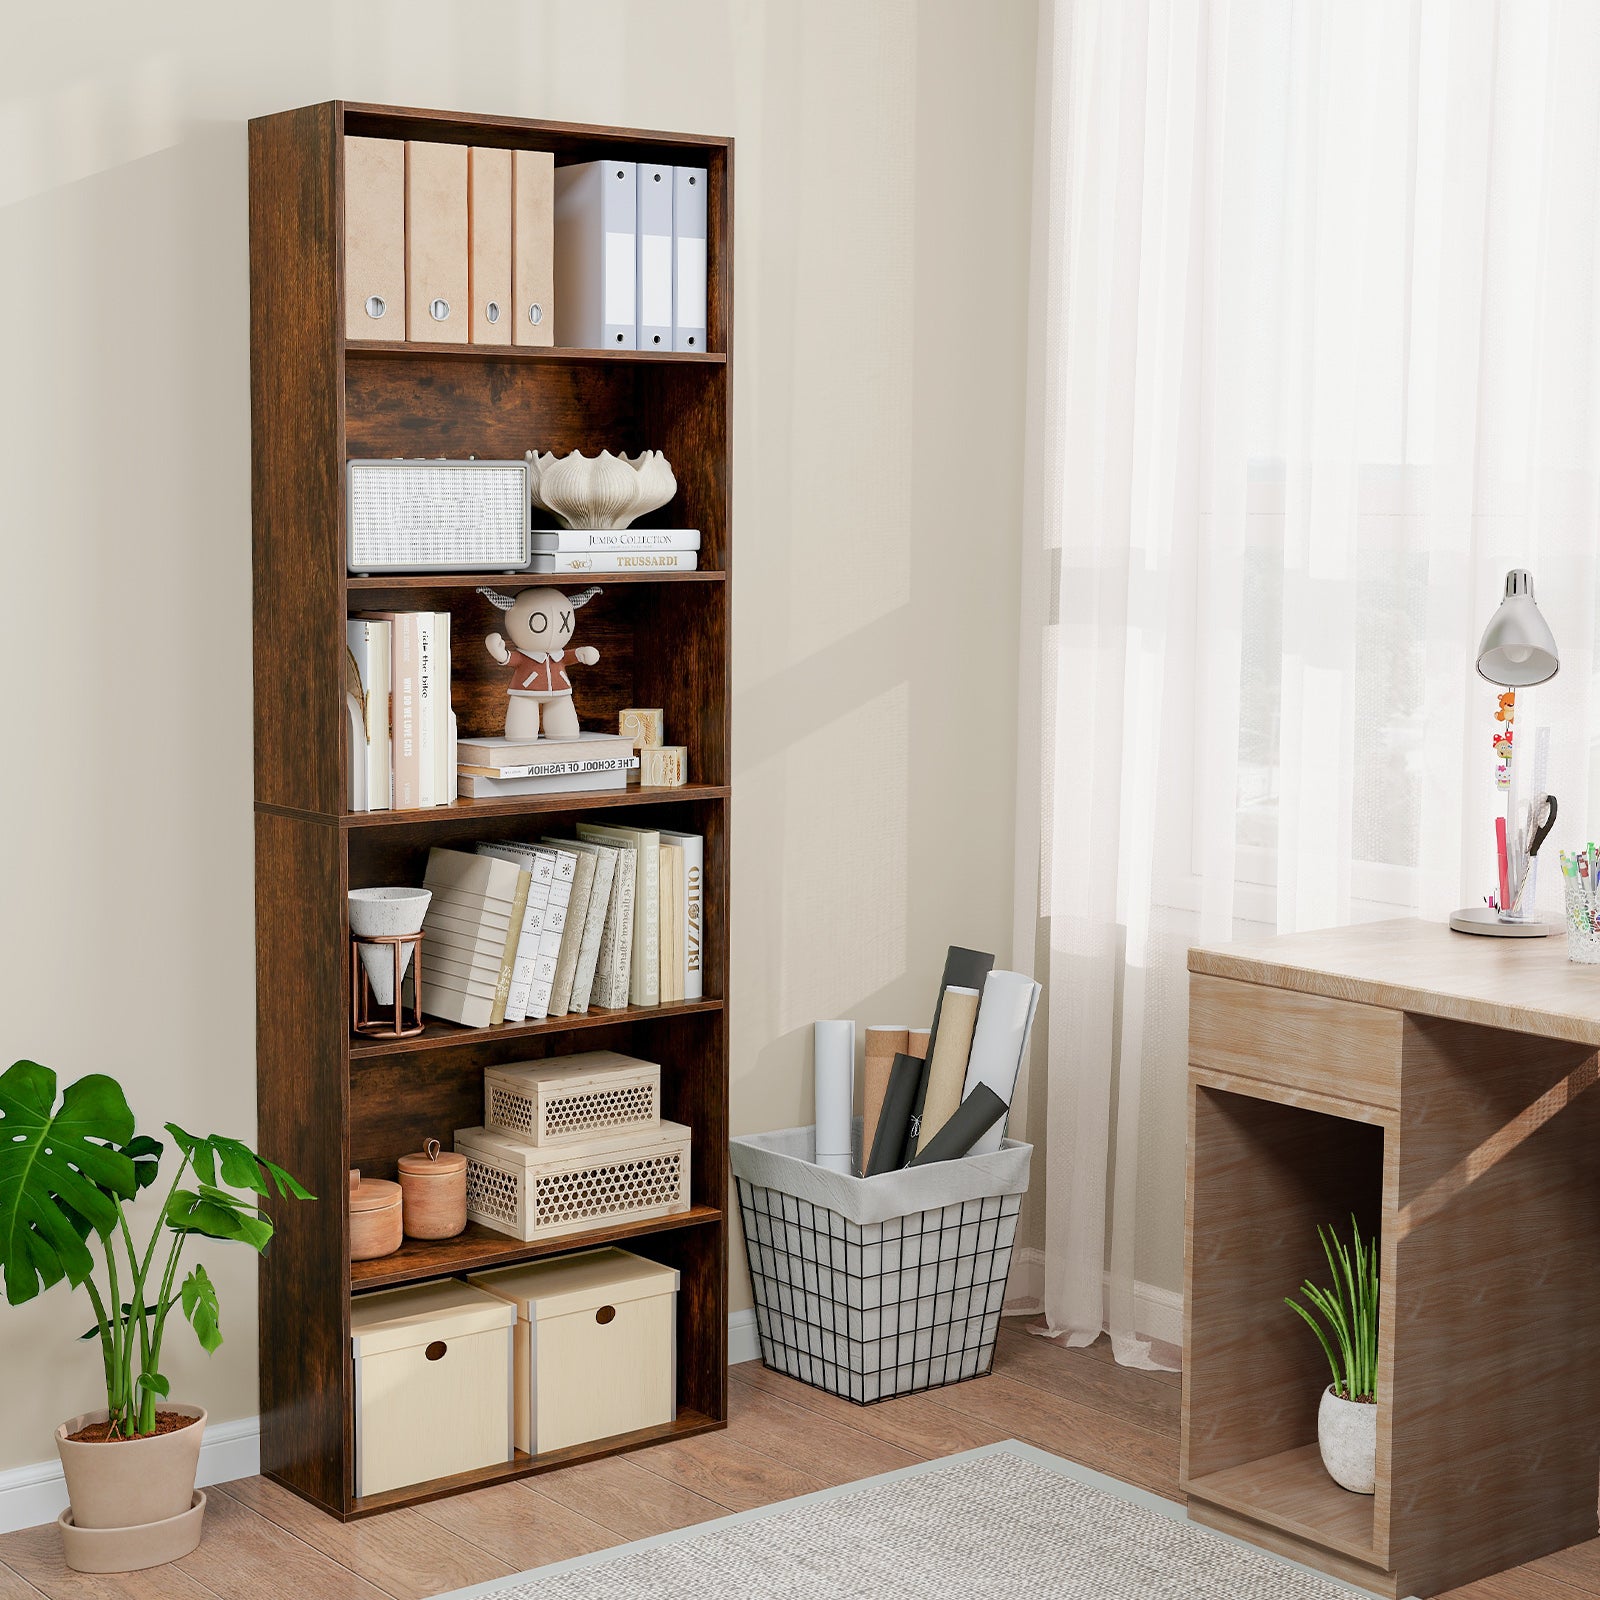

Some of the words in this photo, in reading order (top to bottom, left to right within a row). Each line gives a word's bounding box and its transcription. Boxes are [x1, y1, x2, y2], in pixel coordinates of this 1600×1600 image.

[589, 535, 617, 546] JUMBO
[620, 534, 673, 545] COLLECTION
[617, 555, 679, 567] TRUSSARDI
[421, 675, 429, 699] bike
[403, 720, 412, 738] LOVE
